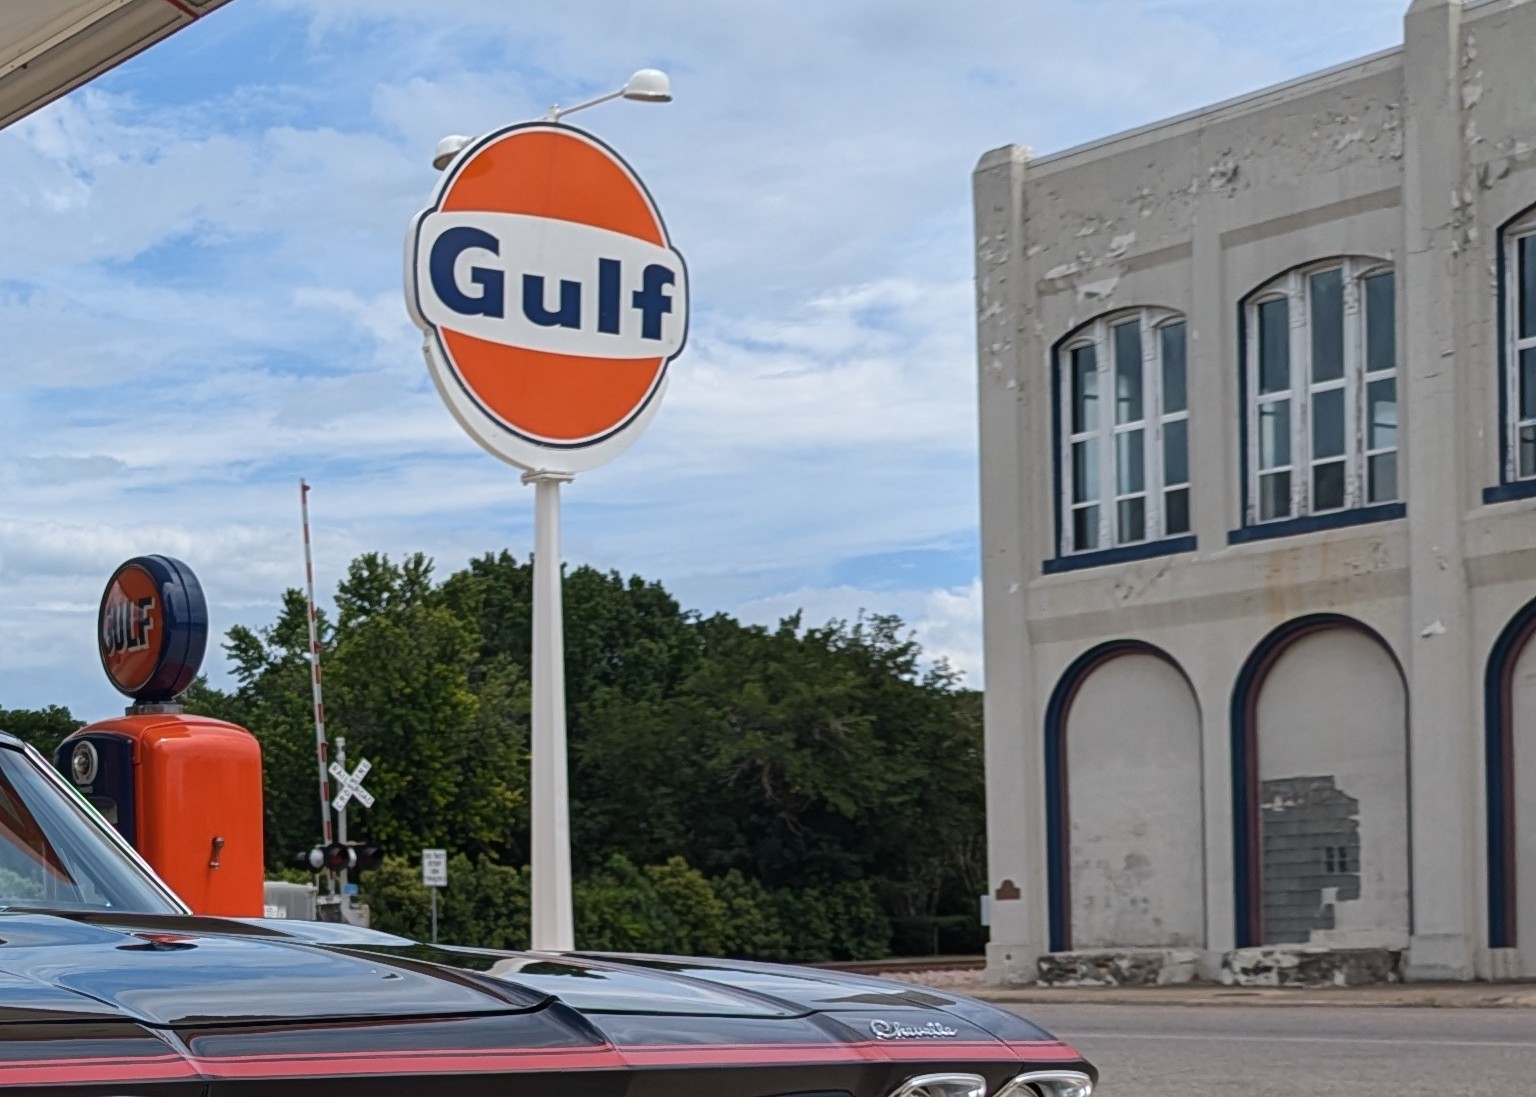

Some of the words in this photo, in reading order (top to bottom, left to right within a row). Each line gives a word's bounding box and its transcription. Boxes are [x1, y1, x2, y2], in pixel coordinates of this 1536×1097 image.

[429, 226, 675, 341] Gulf
[104, 596, 155, 657] GULF
[870, 1019, 958, 1039] Chevelle
